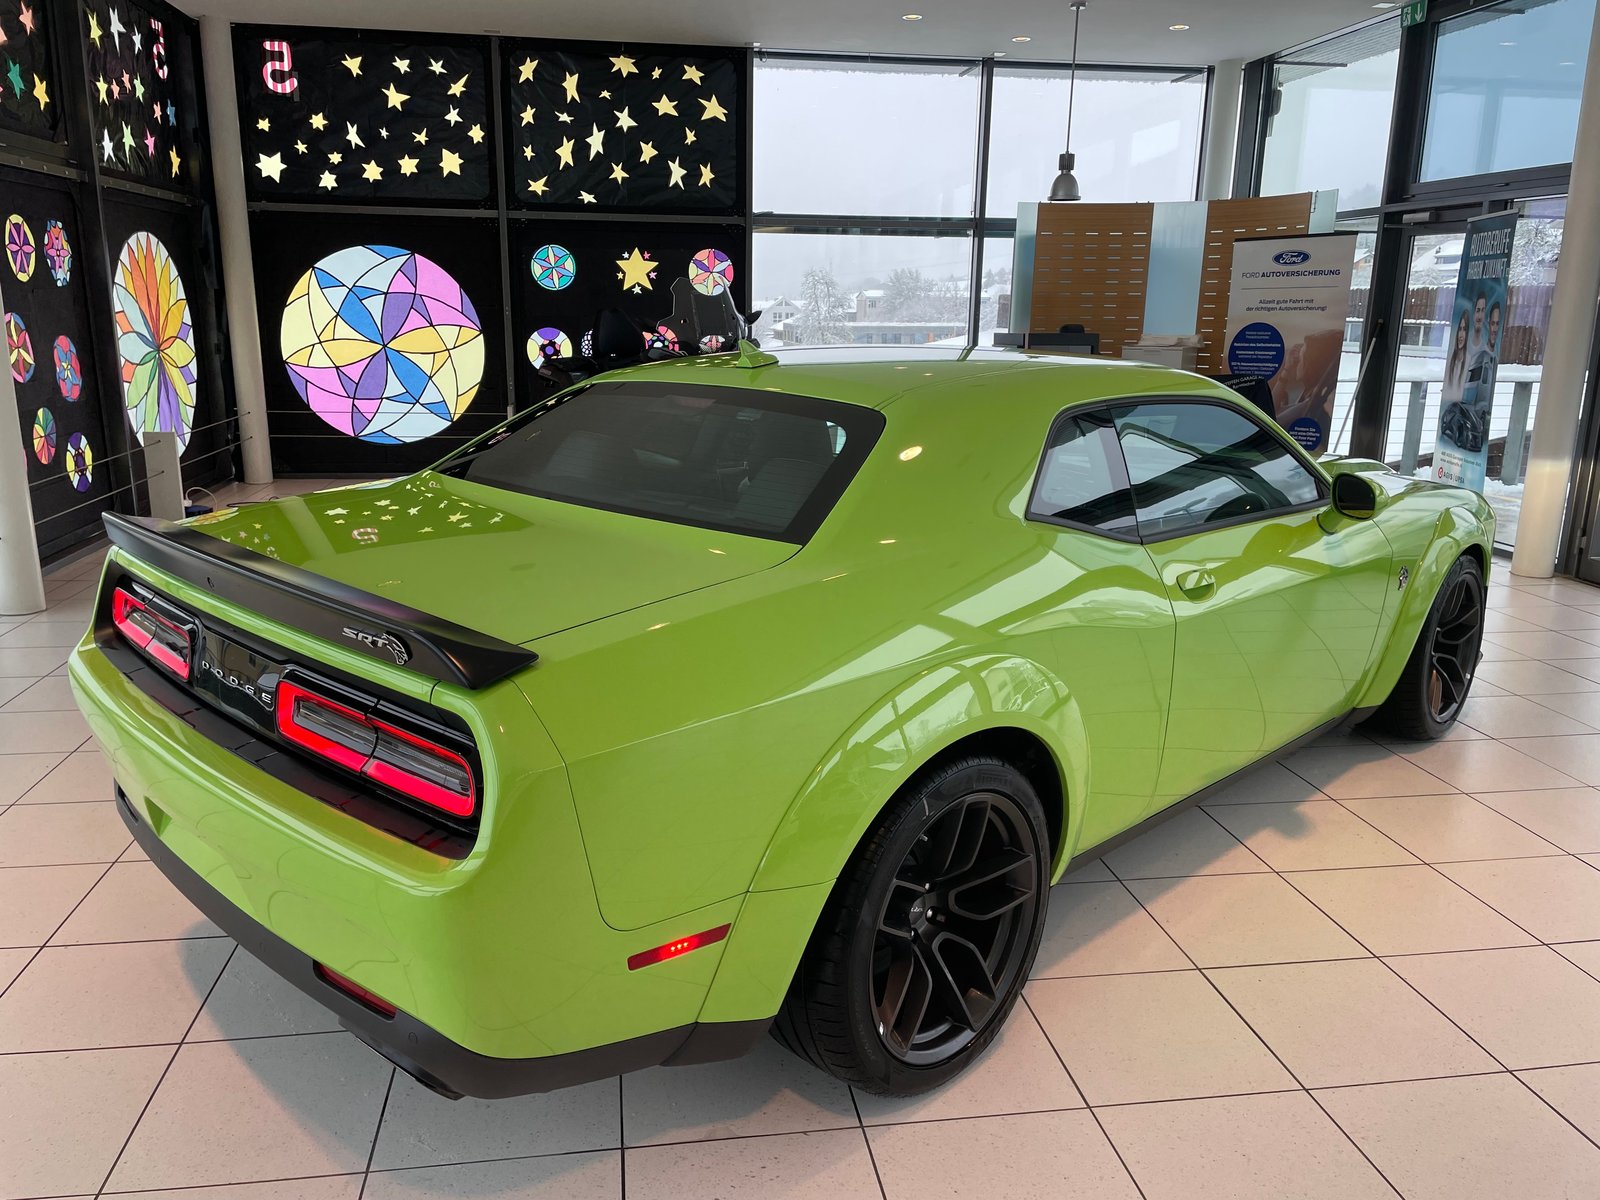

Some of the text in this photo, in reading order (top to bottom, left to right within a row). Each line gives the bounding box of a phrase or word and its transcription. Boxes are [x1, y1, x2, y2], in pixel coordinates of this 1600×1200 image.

[1469, 228, 1511, 257] AUTOBERUFE
[1279, 252, 1304, 264] Ford
[1261, 269, 1341, 278] AUTOVERSICHERUNG
[342, 627, 388, 648] SRT
[202, 660, 272, 704] DODGE
